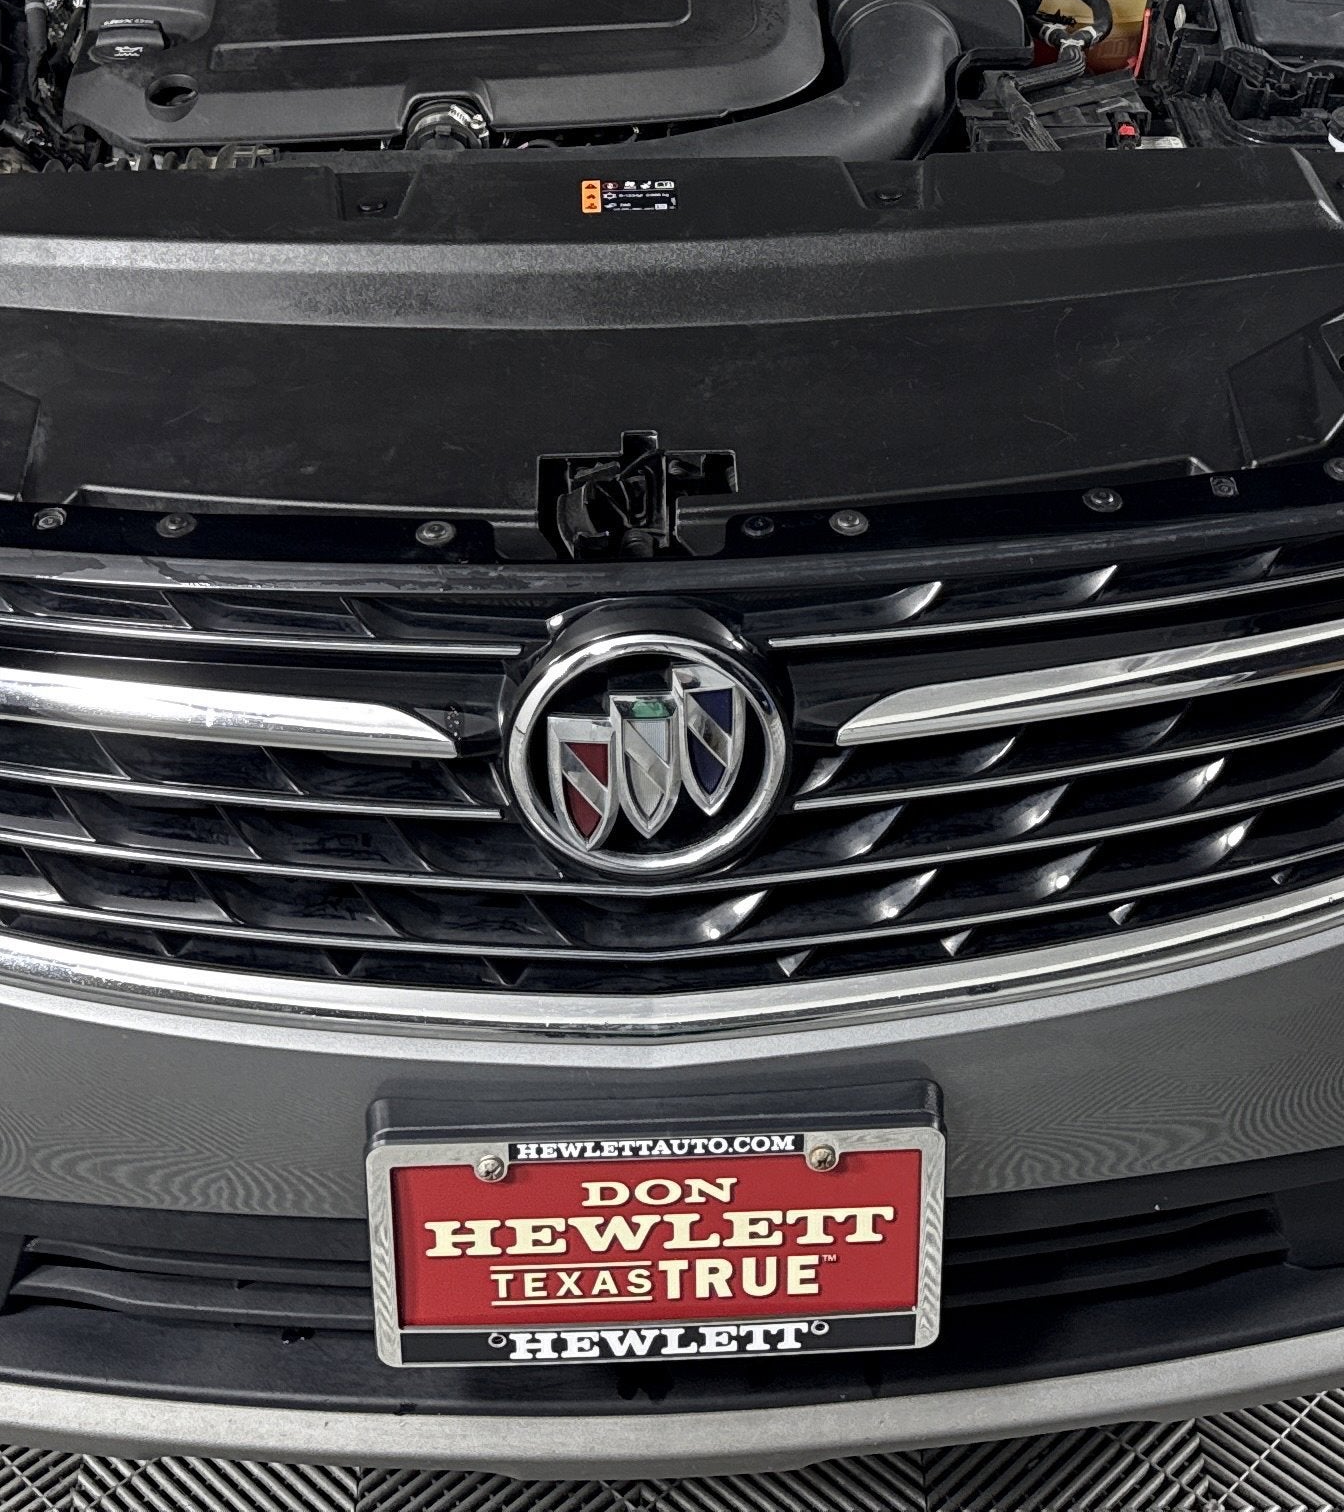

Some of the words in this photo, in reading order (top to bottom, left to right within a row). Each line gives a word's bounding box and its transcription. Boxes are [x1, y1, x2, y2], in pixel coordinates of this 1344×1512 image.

[516, 1135, 795, 1160] HEWLETTAUTO.COM
[581, 1177, 738, 1207] DON
[424, 1206, 895, 1257] HEWLETT
[509, 1322, 808, 1360] HEWLETT
